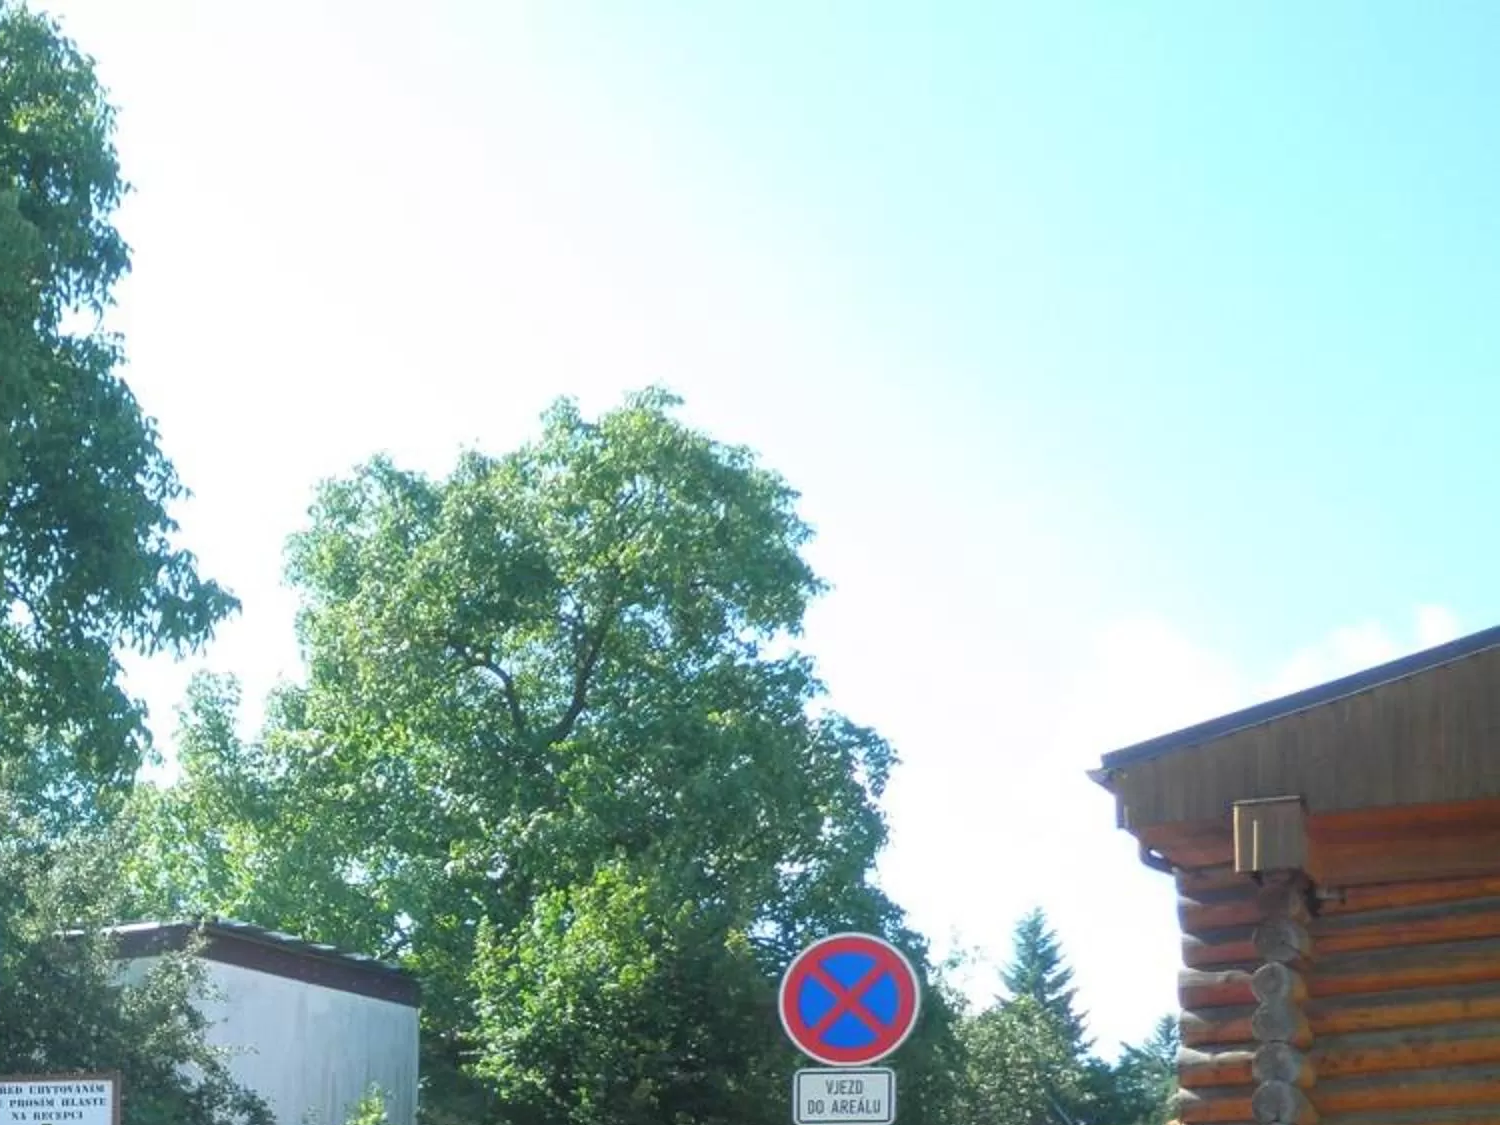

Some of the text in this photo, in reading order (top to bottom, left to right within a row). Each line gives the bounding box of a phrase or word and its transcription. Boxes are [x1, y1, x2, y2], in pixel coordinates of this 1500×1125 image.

[825, 1079, 864, 1095] VJEZD
[807, 1097, 881, 1115] DO AREÁLU
[11, 1111, 83, 1120] NA RECEPCI
